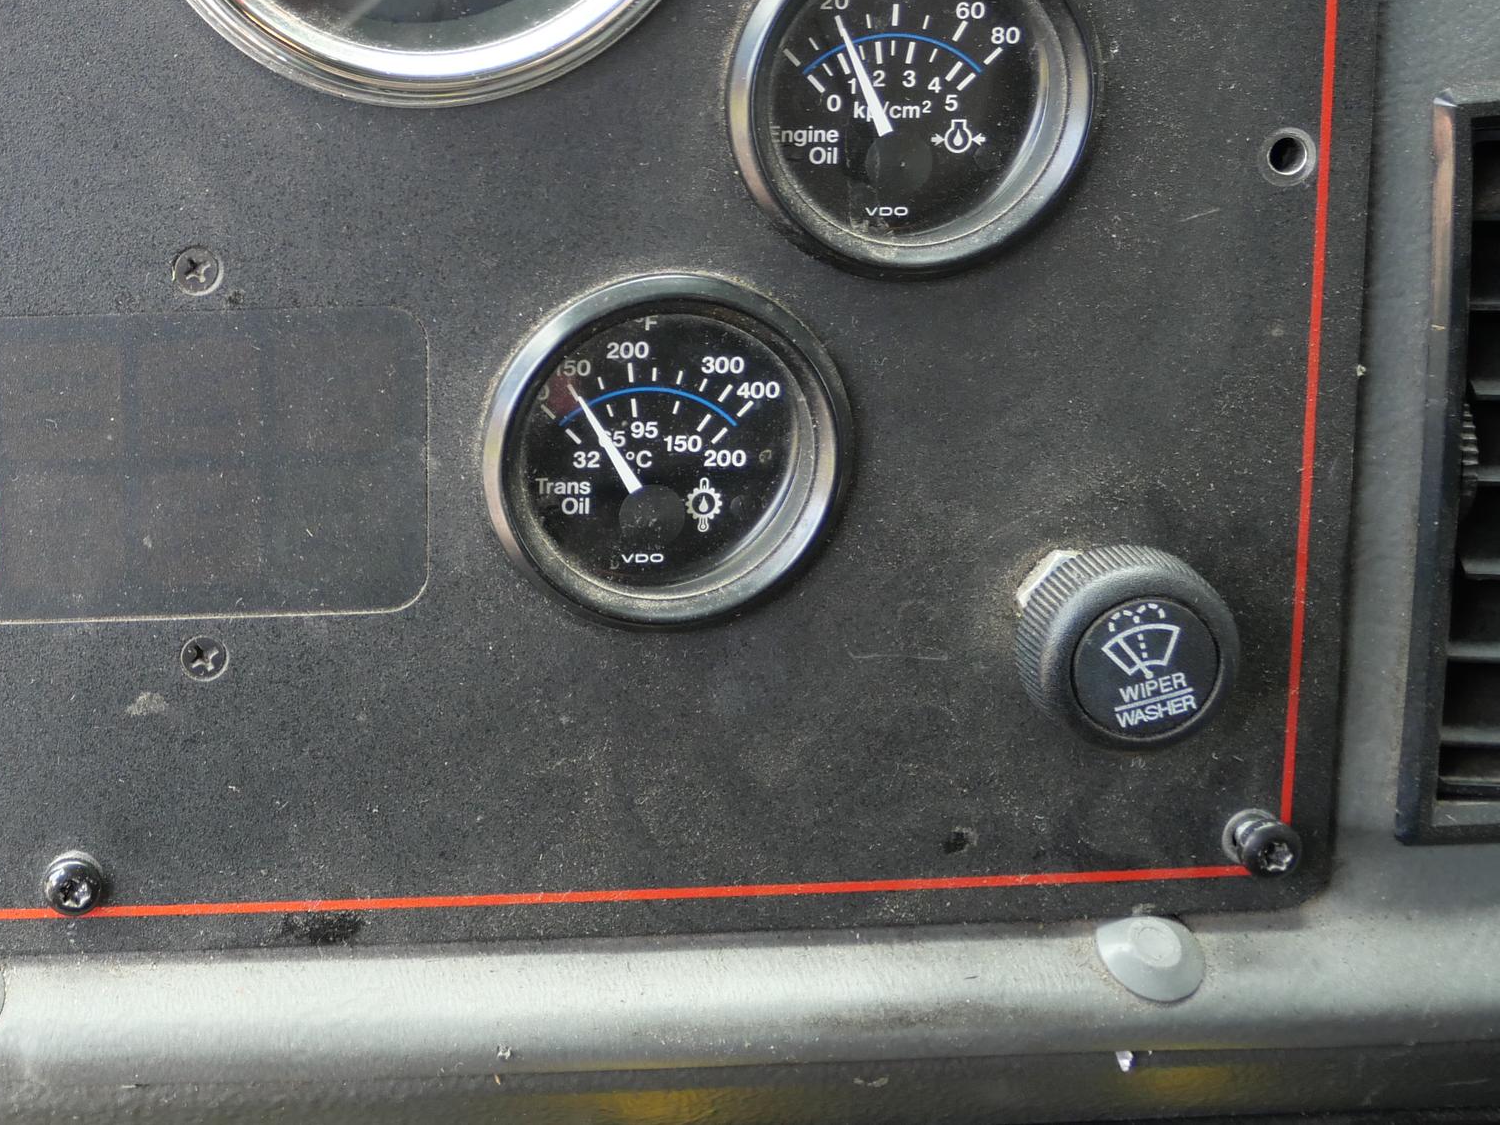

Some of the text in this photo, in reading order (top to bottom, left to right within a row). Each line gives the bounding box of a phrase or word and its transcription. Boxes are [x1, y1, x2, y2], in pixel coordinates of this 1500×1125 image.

[956, 2, 985, 20] 60
[990, 27, 1020, 44] 80
[848, 78, 856, 94] 1
[873, 70, 885, 87] 2
[902, 70, 916, 87] 3
[928, 77, 941, 93] 4
[826, 95, 842, 112] 0
[944, 94, 958, 112] 5
[770, 125, 839, 146] Engine
[809, 147, 838, 164] Oil
[865, 207, 909, 216] VDO
[606, 342, 649, 359] 200
[702, 357, 744, 374] 300
[737, 381, 780, 399] 400
[631, 421, 658, 438] 95
[664, 435, 702, 453] 150
[573, 451, 600, 468] 32
[626, 450, 652, 468] °C
[704, 450, 746, 467] 200
[535, 478, 591, 495] Trans
[561, 497, 590, 515] Oil
[621, 553, 664, 564] VDO
[1119, 672, 1187, 703] WIPER
[1115, 694, 1197, 728] WASHER
